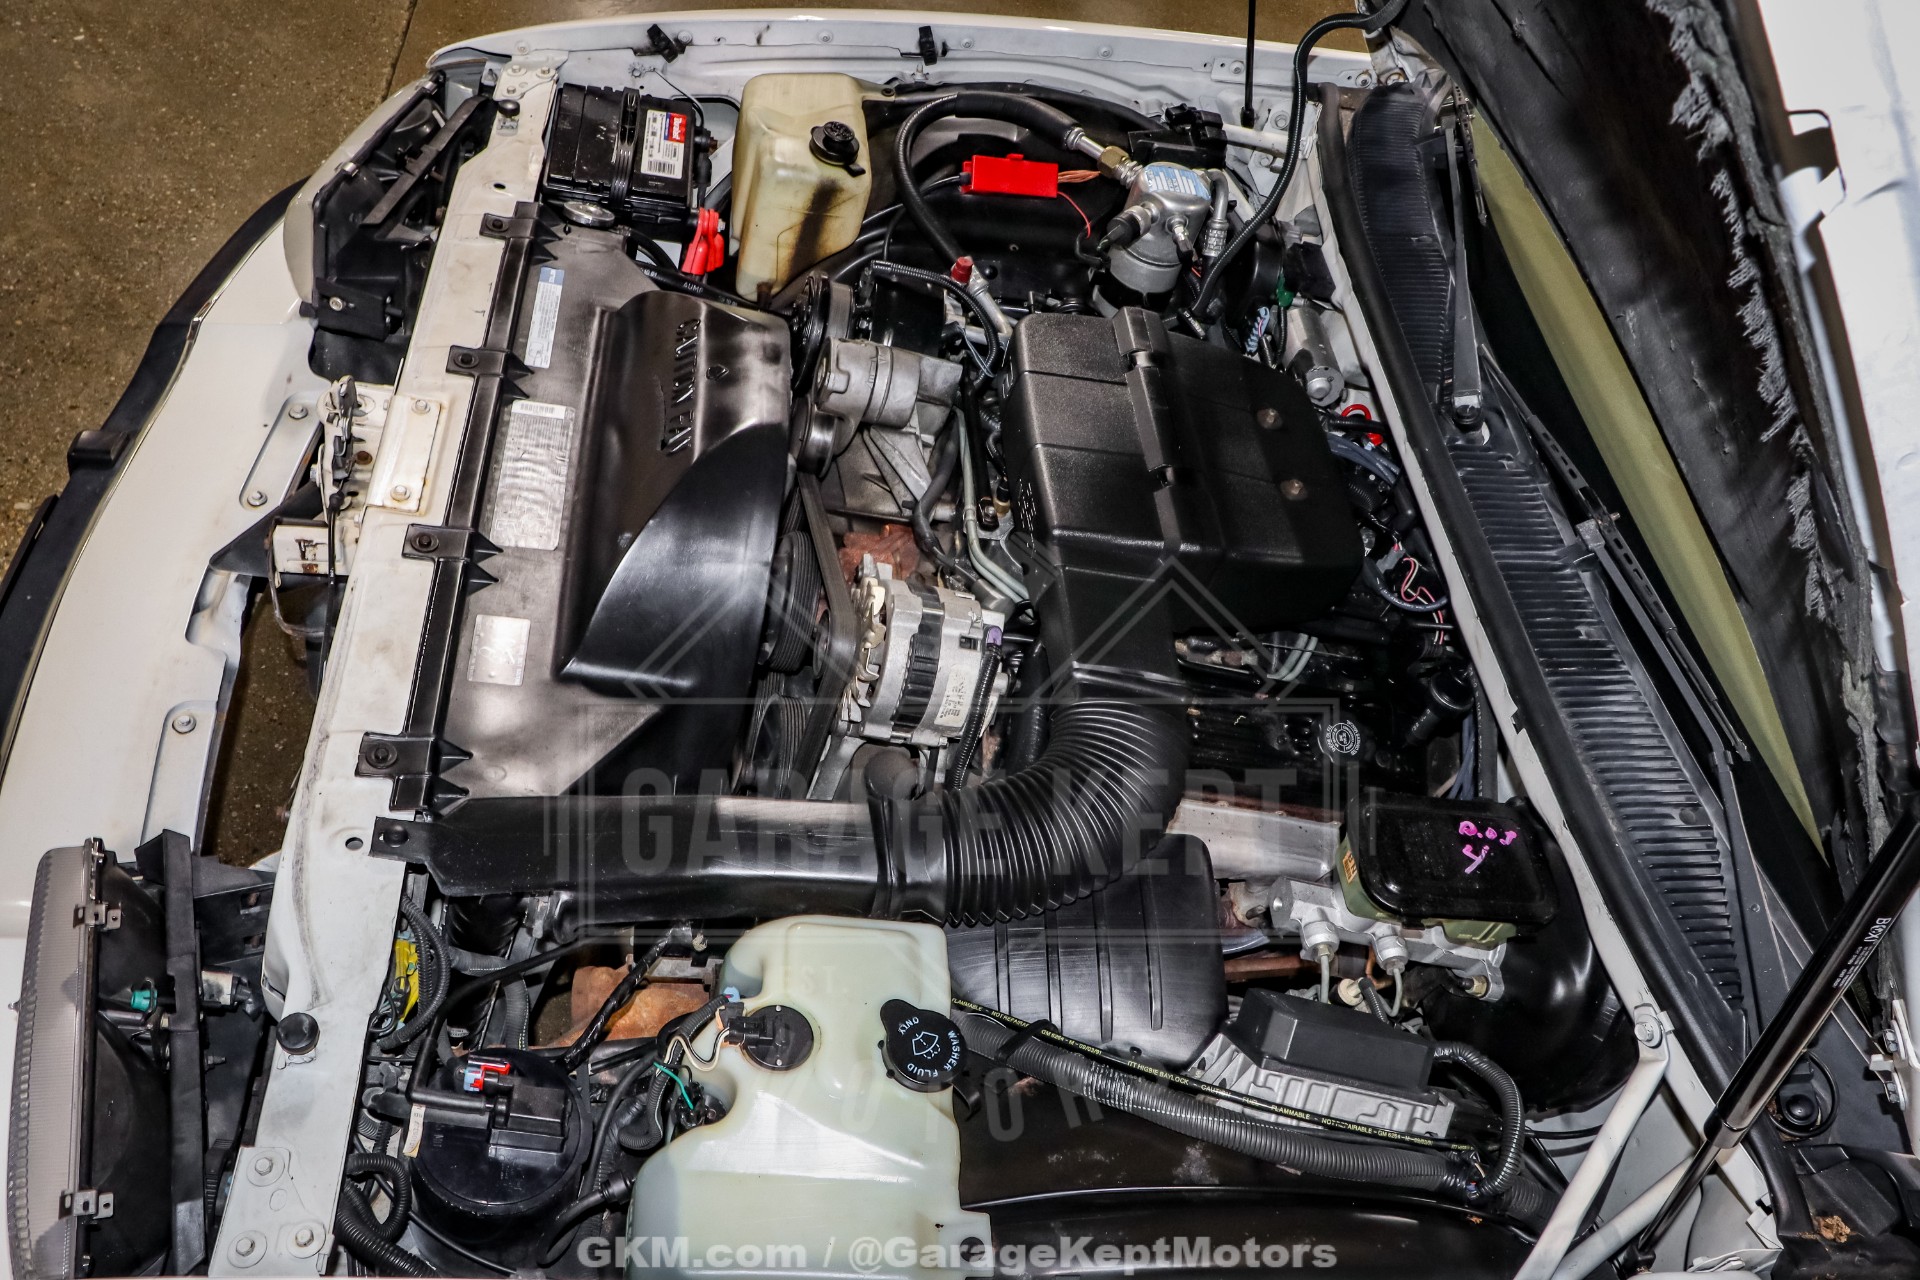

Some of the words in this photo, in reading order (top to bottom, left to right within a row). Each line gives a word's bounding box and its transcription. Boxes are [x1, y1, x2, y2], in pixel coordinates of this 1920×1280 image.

[898, 1016, 919, 1035] ONLY
[943, 1030, 961, 1071] WASHER
[907, 1063, 939, 1078] FLUID
